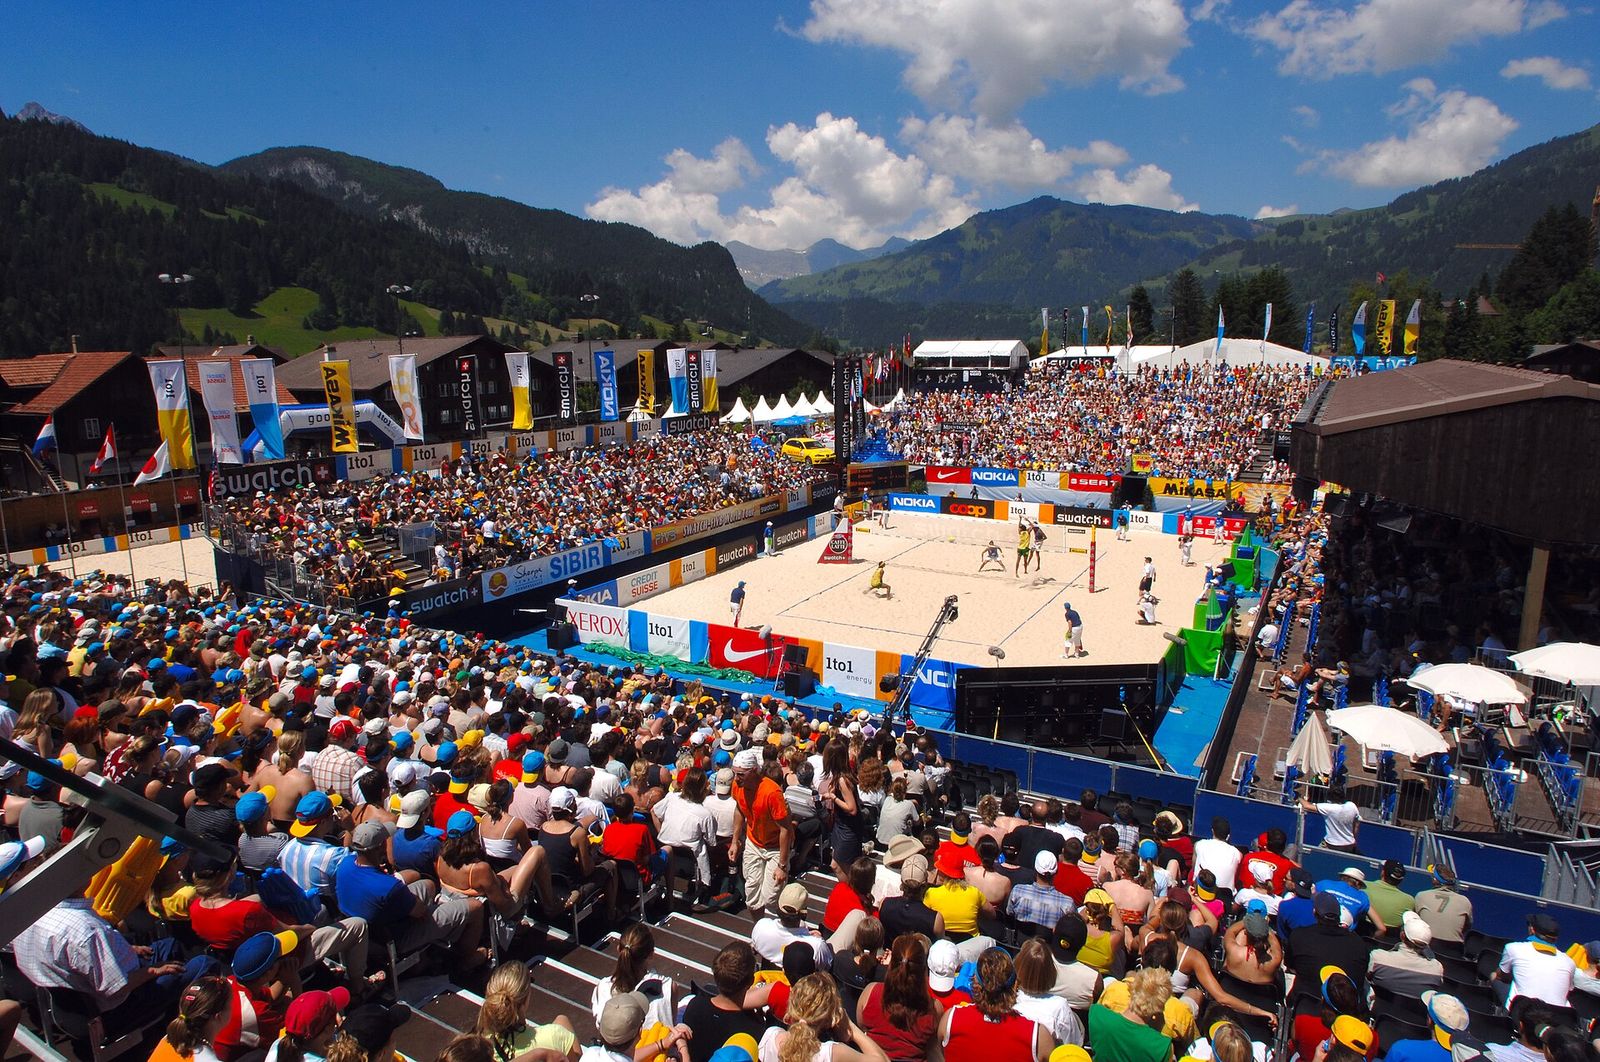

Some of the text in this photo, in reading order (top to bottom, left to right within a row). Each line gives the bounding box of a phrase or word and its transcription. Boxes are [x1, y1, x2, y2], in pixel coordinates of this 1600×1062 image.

[600, 425, 615, 437] 1to1
[638, 422, 652, 432] 1to1
[669, 417, 711, 433] swatch
[517, 435, 536, 448] 1to1
[558, 431, 575, 442] 1to1
[842, 420, 850, 458] swatch
[472, 442, 492, 453] 1to1
[413, 448, 437, 461] 1to1
[348, 455, 375, 470] 1to1
[214, 463, 313, 496] swatch
[973, 471, 1017, 482] NOKIA
[1026, 471, 1046, 482] 1to1
[787, 491, 799, 503] 1to1
[813, 486, 835, 498] swatch
[760, 503, 776, 514] swatch
[893, 497, 936, 509] NOKIA
[949, 503, 987, 517] coop
[1010, 506, 1027, 515] 1to1
[1057, 513, 1102, 525] swatch
[1130, 514, 1149, 524] 1to1
[130, 530, 153, 544] 1to1
[777, 529, 802, 546] swatch
[61, 542, 87, 555] 1to1
[718, 545, 749, 565] swatch
[550, 546, 600, 579] SIBIR
[682, 561, 696, 573] 1to1
[631, 571, 658, 587] CREDIT
[631, 580, 659, 598] SUISSE
[410, 587, 468, 615] swatch
[568, 610, 624, 637] XEROX
[649, 622, 673, 638] 1to1
[667, 639, 690, 649] energy
[826, 656, 853, 673] 1to1
[846, 674, 873, 685] energy
[1434, 893, 1449, 912] 7
